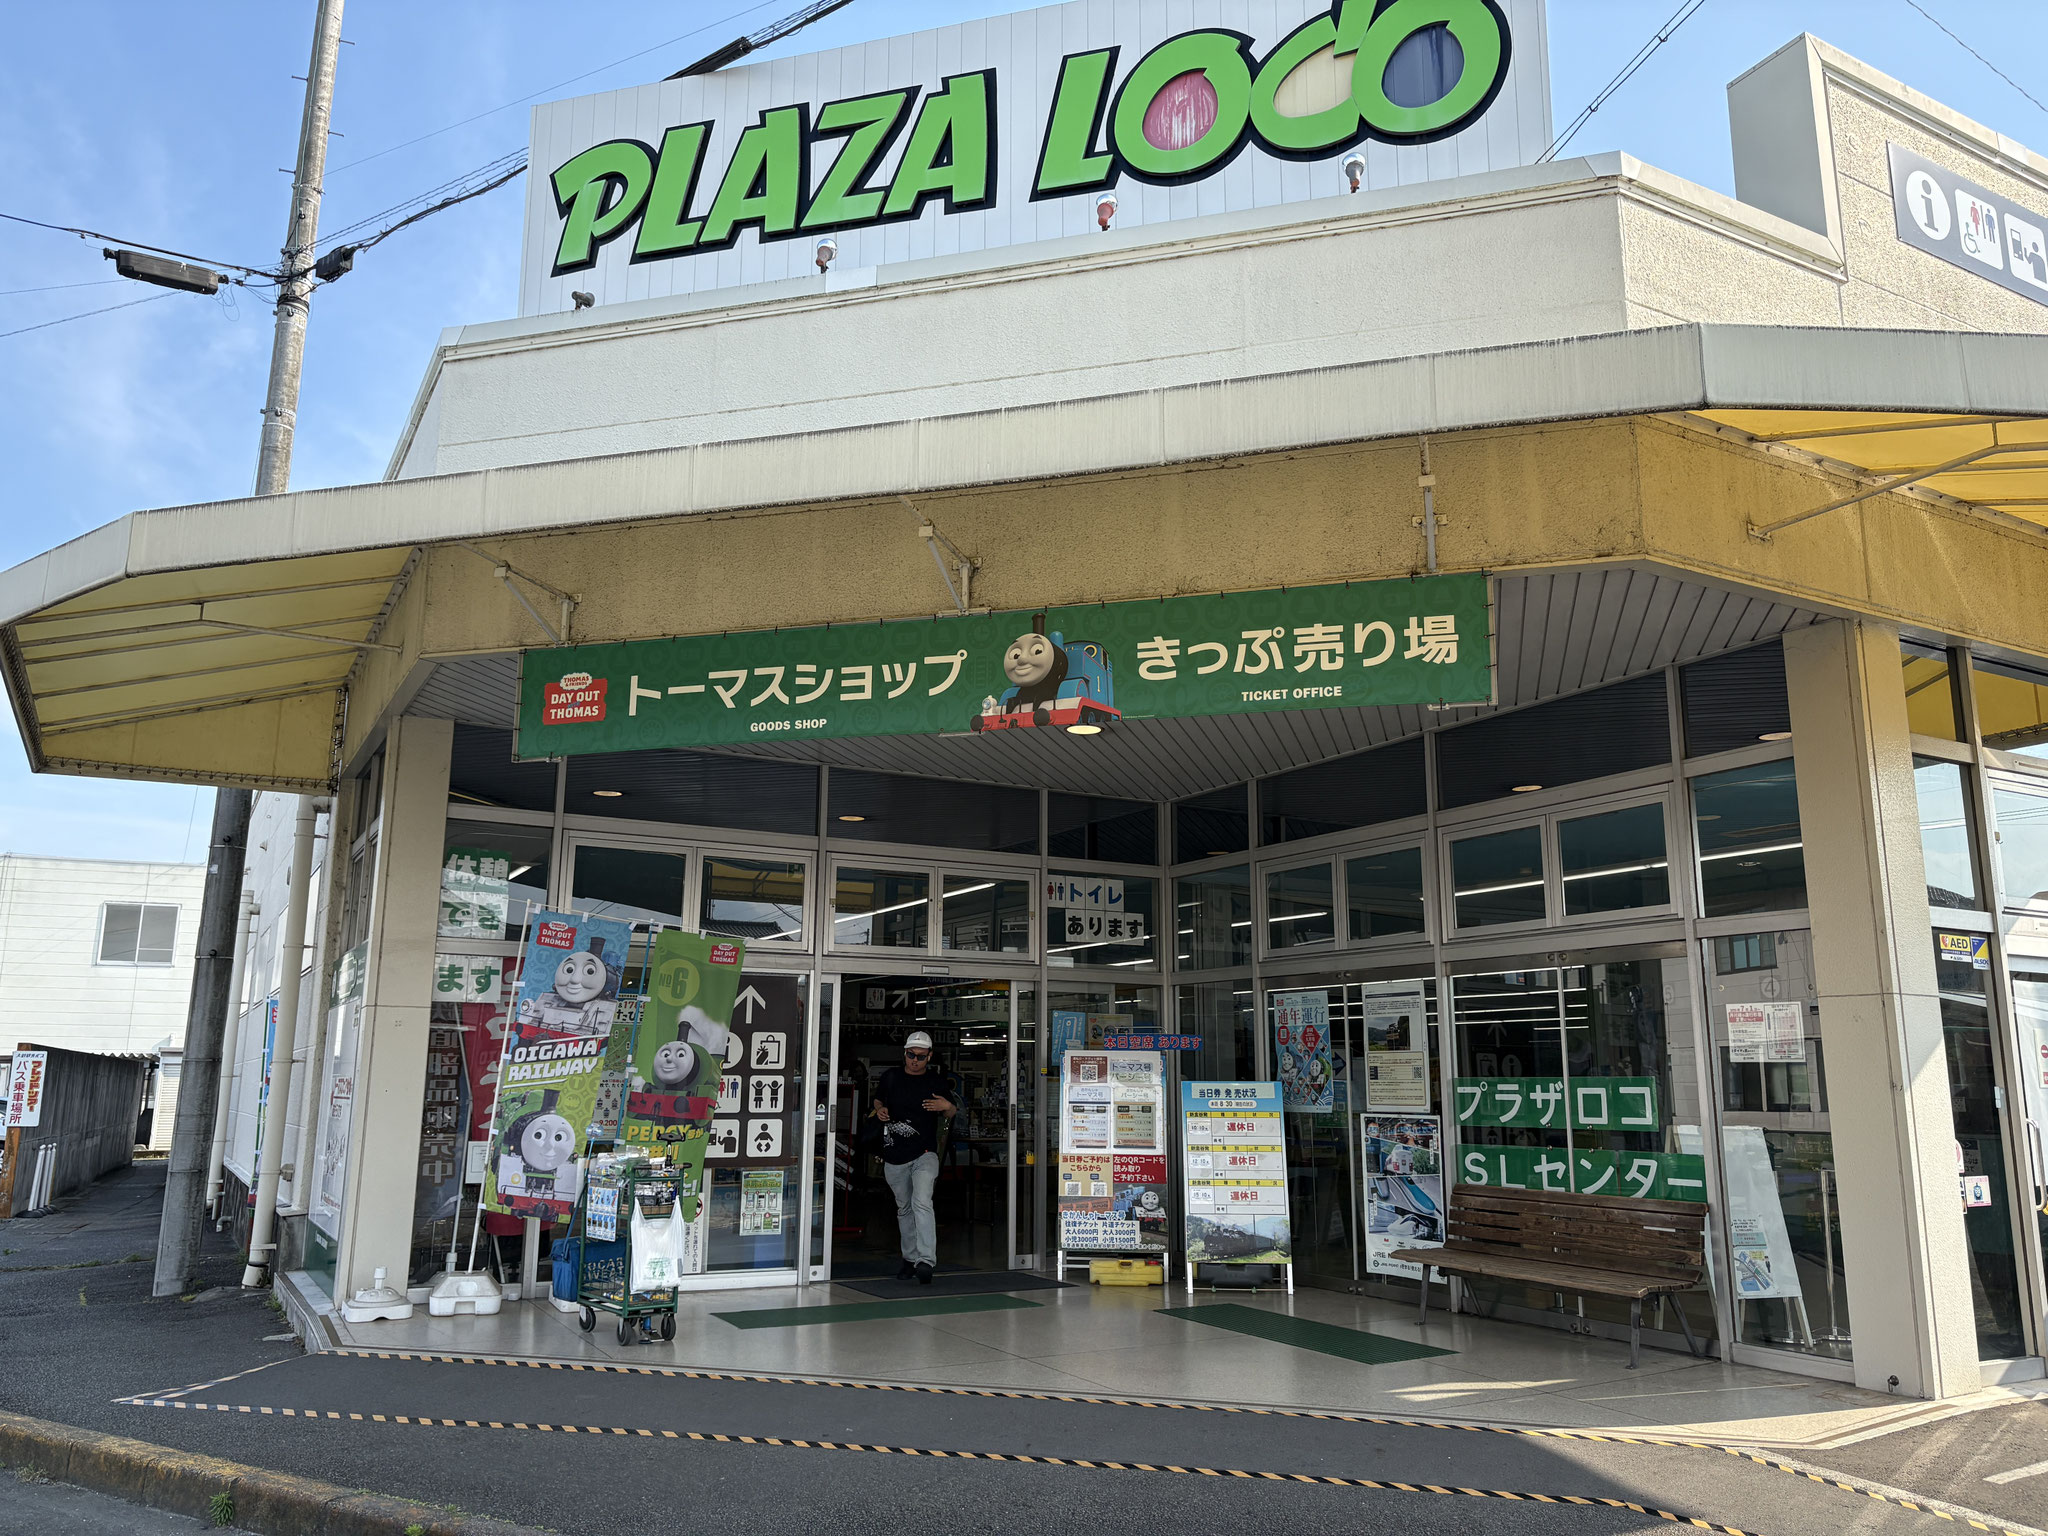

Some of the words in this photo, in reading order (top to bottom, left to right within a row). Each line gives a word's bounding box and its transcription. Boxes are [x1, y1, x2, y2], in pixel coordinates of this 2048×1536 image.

[550, 68, 997, 278] PLAZA
[1030, 0, 1513, 203] LOCO
[1136, 614, 1460, 681] きっぷ売り場
[628, 648, 968, 717] トーマスショップ
[551, 692, 574, 705] DAY
[576, 690, 600, 702] OUT
[1241, 688, 1289, 702] TICKET
[1293, 685, 1342, 700] OFFICE
[550, 705, 600, 720] THOMAS
[750, 720, 791, 733] GOODS
[794, 718, 827, 732] SHOP
[445, 853, 510, 887] 休憩
[1070, 882, 1123, 905] トイレ
[542, 929, 556, 937] DAY
[557, 932, 572, 940] OUT
[1067, 916, 1143, 939] あります
[541, 937, 570, 947] THOMAS
[1950, 937, 1969, 949] AED
[437, 964, 501, 995] ます
[1278, 1006, 1325, 1025] 通年運行
[1103, 1035, 1154, 1049] 本日空席
[1158, 1035, 1202, 1049] あります
[514, 1040, 598, 1063] OIGAWA
[508, 1058, 598, 1082] RAILWAY
[1111, 1062, 1152, 1072] トーマス号
[9, 1060, 29, 1125] バス乗車場所
[27, 1060, 43, 1112] フレンドツアー
[1199, 1088, 1221, 1098] 当日券
[1456, 1081, 1653, 1126] プラザロコ
[1226, 1122, 1255, 1132] 運休日
[1062, 1155, 1111, 1163] 当日券ご予約は
[1113, 1156, 1166, 1164] 左のQRコードを
[1228, 1156, 1257, 1165] 運休日
[1070, 1164, 1102, 1172] こちらから
[1113, 1164, 1141, 1173] 読み取り
[1464, 1152, 1703, 1199] SLセンター
[1113, 1174, 1155, 1182] ご予約下さい
[1230, 1191, 1259, 1201] 運休日
[1062, 1210, 1126, 1220] きかんしゃトーマス号
[1065, 1220, 1099, 1228] 往復チケット
[1102, 1221, 1136, 1229] 片道チケット
[1102, 1236, 1136, 1244] 小児1500円
